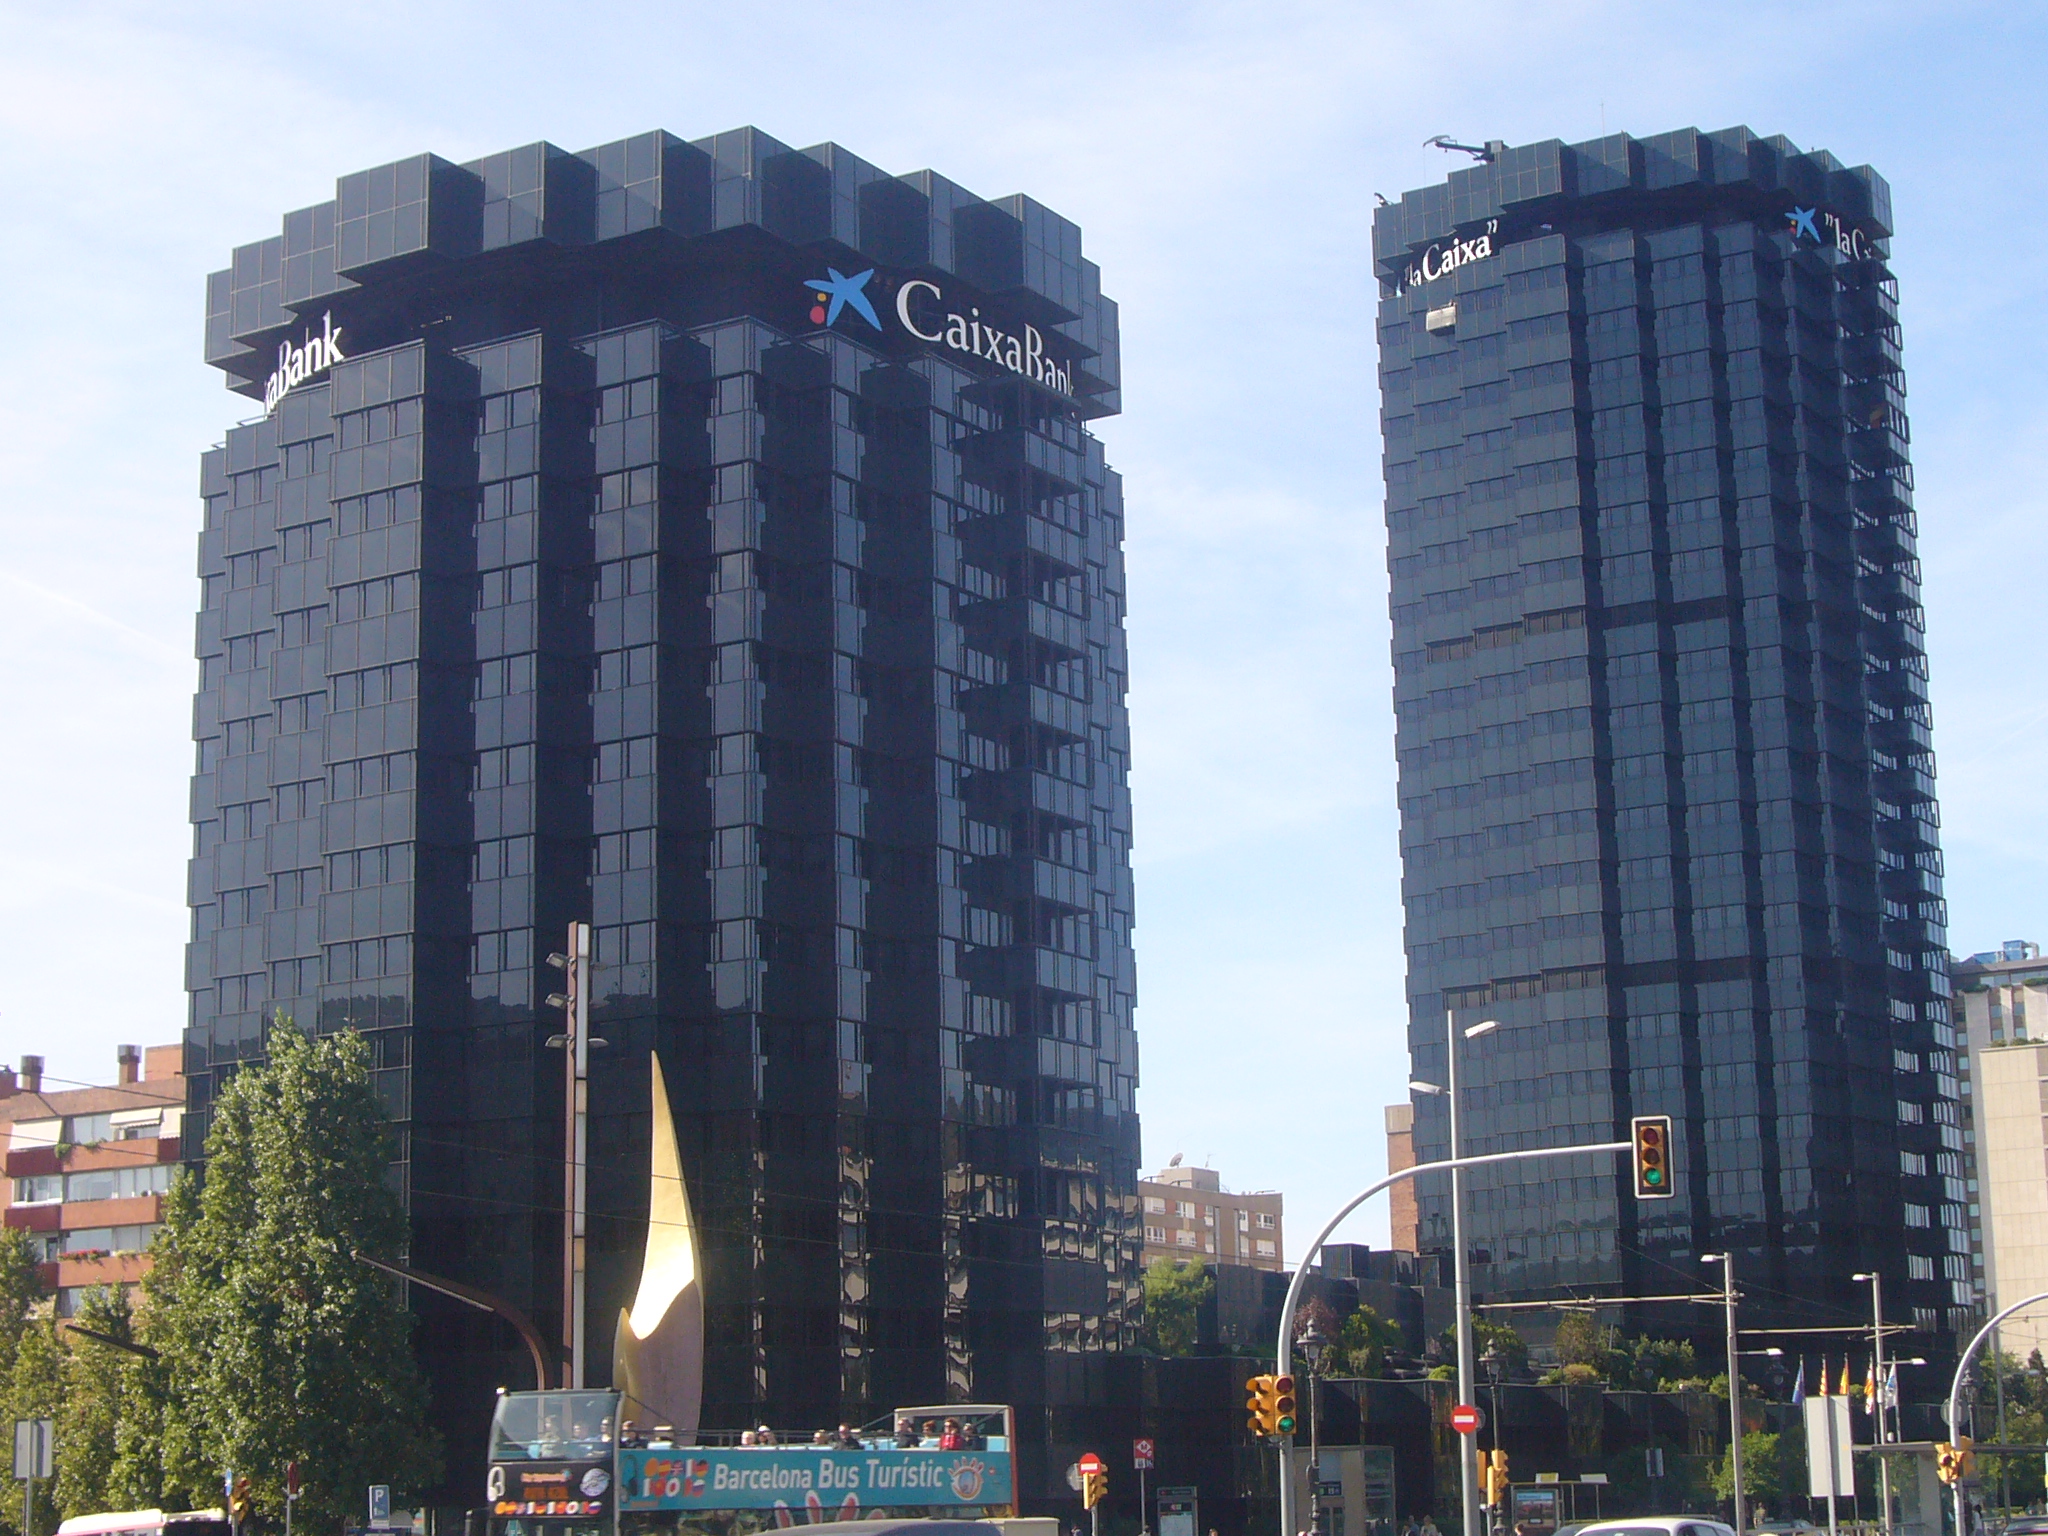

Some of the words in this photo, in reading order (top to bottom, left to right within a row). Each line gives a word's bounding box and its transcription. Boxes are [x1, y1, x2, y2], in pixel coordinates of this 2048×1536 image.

[713, 1463, 813, 1490] Barcelona
[818, 1458, 860, 1489] Bus
[866, 1456, 944, 1488] Turístic
[374, 1488, 385, 1503] P
